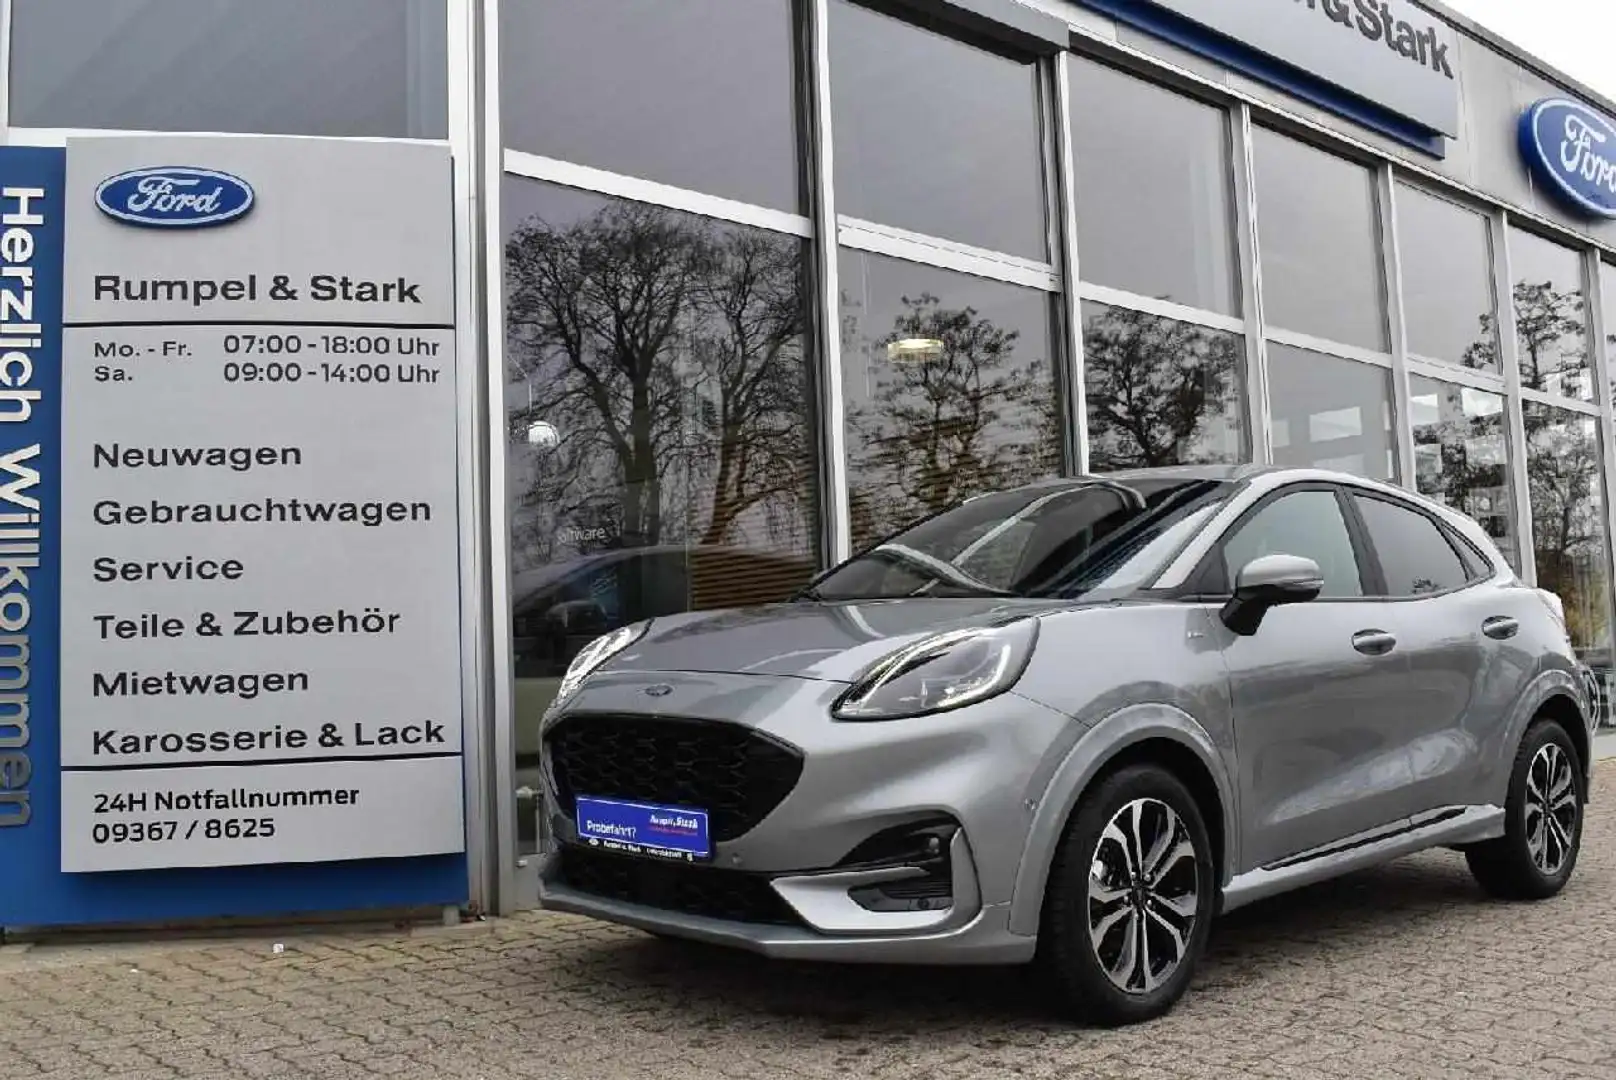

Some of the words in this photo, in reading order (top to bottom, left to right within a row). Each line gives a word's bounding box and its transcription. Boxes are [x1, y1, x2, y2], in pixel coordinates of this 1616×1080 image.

[1354, 0, 1454, 80] Stark
[126, 175, 224, 213] Ford
[0, 186, 44, 422] Herzlich
[94, 275, 257, 306] Rumpel
[269, 275, 299, 301] &
[310, 274, 422, 303] Stark
[94, 341, 141, 358] Mo.
[162, 340, 193, 357] Fr.
[223, 335, 302, 354] 07:00
[321, 335, 391, 355] 18:00
[397, 336, 440, 356] Uhr
[94, 365, 133, 383] Sa.
[223, 363, 302, 383] 09:00
[321, 363, 391, 383] 14:00
[397, 363, 441, 383] Uhr
[93, 443, 302, 472] Neuwagen
[93, 497, 431, 527] Gebrauchtwagen
[93, 555, 244, 583] Service
[0, 443, 41, 827] Willkommen
[93, 613, 185, 639] Teile
[195, 611, 224, 637] &
[233, 607, 401, 636] Zubehör
[93, 671, 309, 699] Mietwagen
[93, 724, 308, 755] Karosserie
[317, 723, 345, 748] &
[354, 719, 446, 747] Lack
[93, 791, 147, 814] 24H
[154, 788, 360, 811] Notfallnummer
[92, 820, 178, 844] 09367
[184, 819, 199, 840] /
[204, 817, 276, 839] 8625
